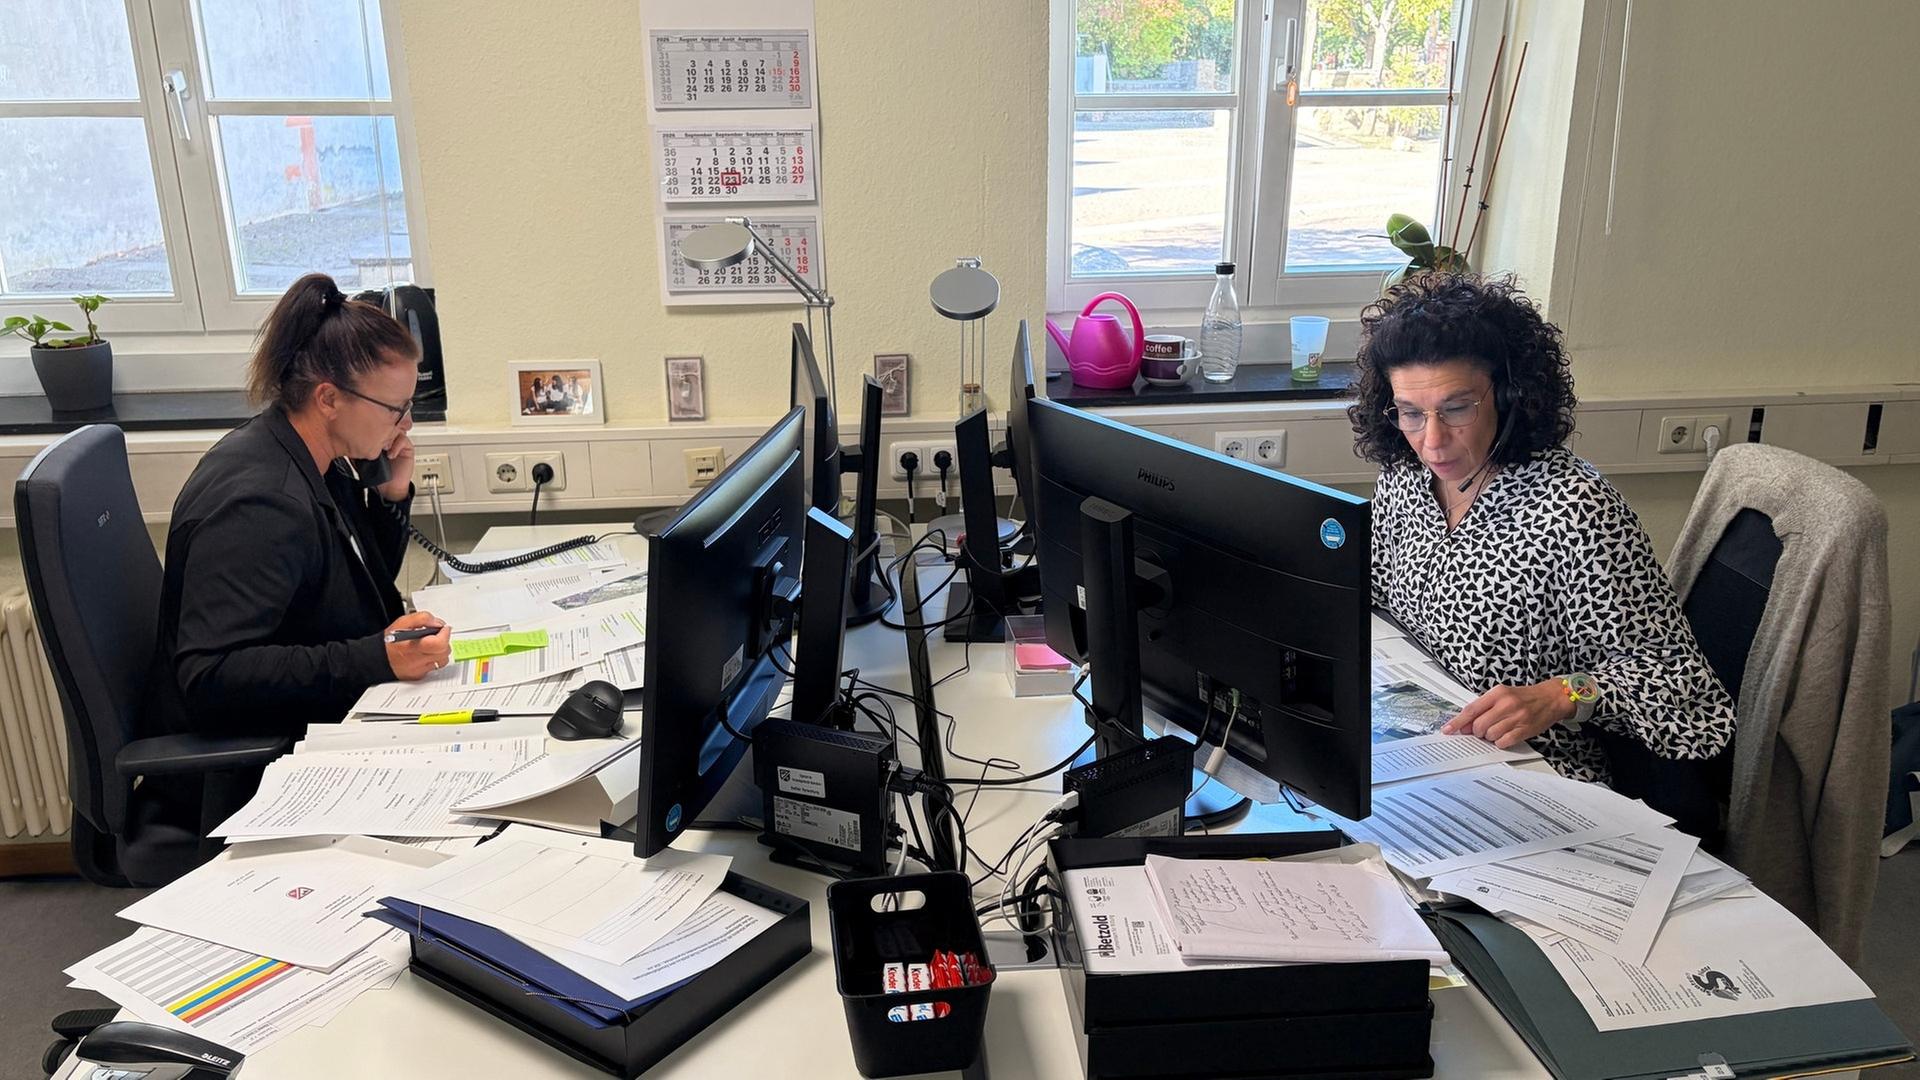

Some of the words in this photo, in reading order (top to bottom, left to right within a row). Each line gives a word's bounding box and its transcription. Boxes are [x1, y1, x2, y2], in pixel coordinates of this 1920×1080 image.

[1146, 344, 1172, 353] coffee
[1137, 468, 1176, 491] PHILIPS
[888, 966, 898, 989] Kinder
[911, 968, 922, 990] Kinder
